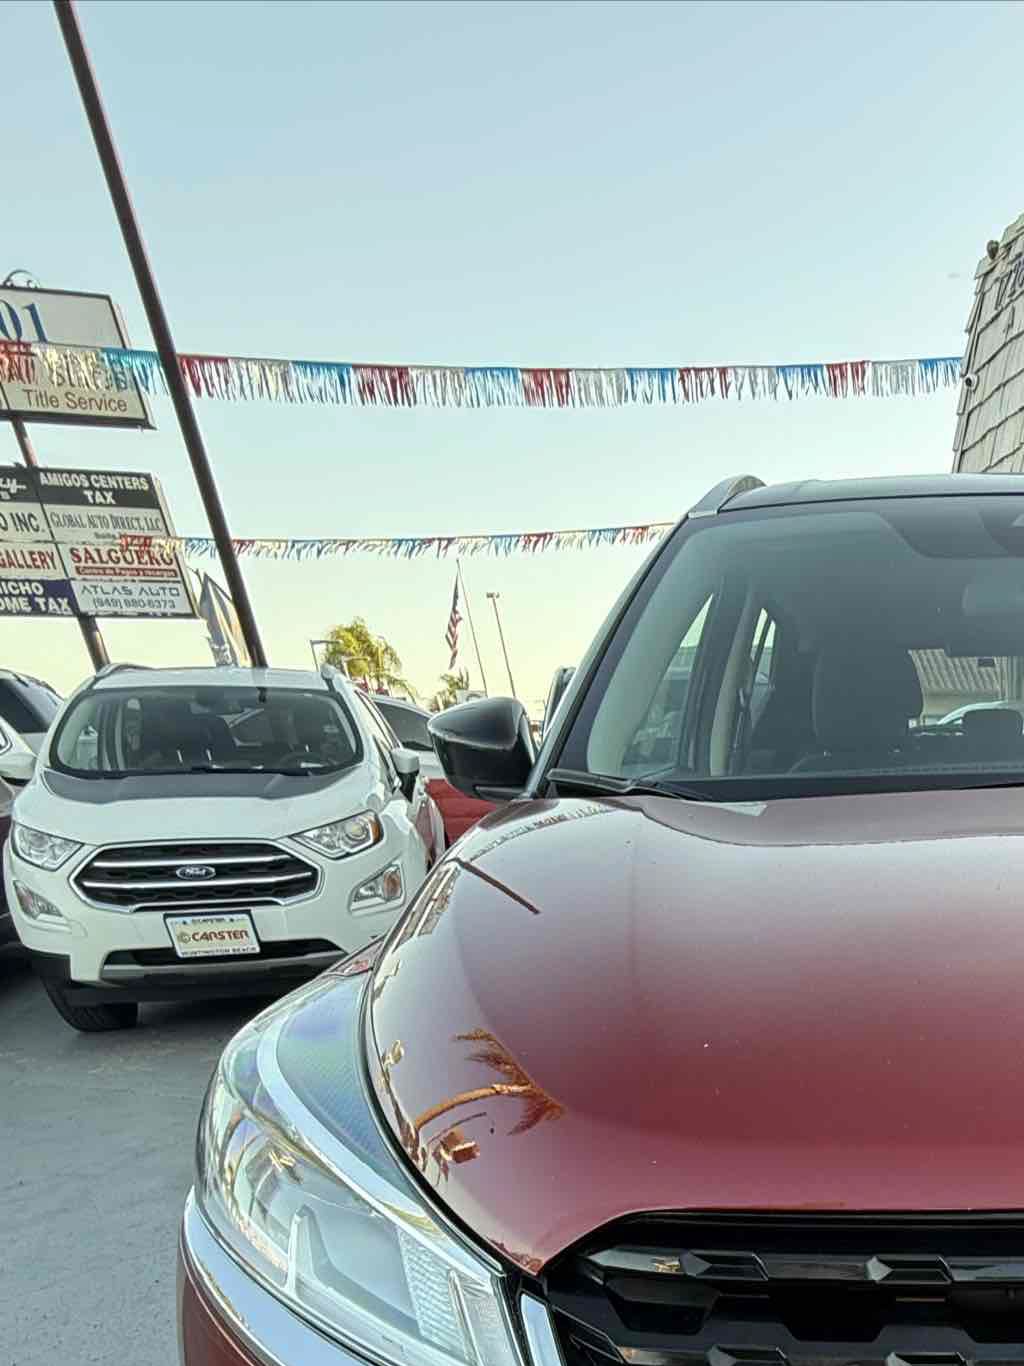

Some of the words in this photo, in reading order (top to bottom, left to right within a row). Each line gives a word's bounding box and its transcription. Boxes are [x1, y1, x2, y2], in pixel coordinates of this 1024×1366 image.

[22, 389, 60, 409] Title
[64, 391, 128, 413] Service
[39, 472, 89, 488] AMIGOS
[90, 474, 149, 491] CENTERS
[83, 490, 116, 504] TAX
[10, 512, 45, 532] INC.
[50, 511, 87, 529] GLOBAL
[88, 512, 110, 530] AUTO
[0, 581, 44, 595] ICHO
[81, 584, 132, 596] ATLAS
[138, 586, 180, 597] AUTO
[34, 597, 72, 615] TAX
[191, 930, 249, 942] CARSTER
